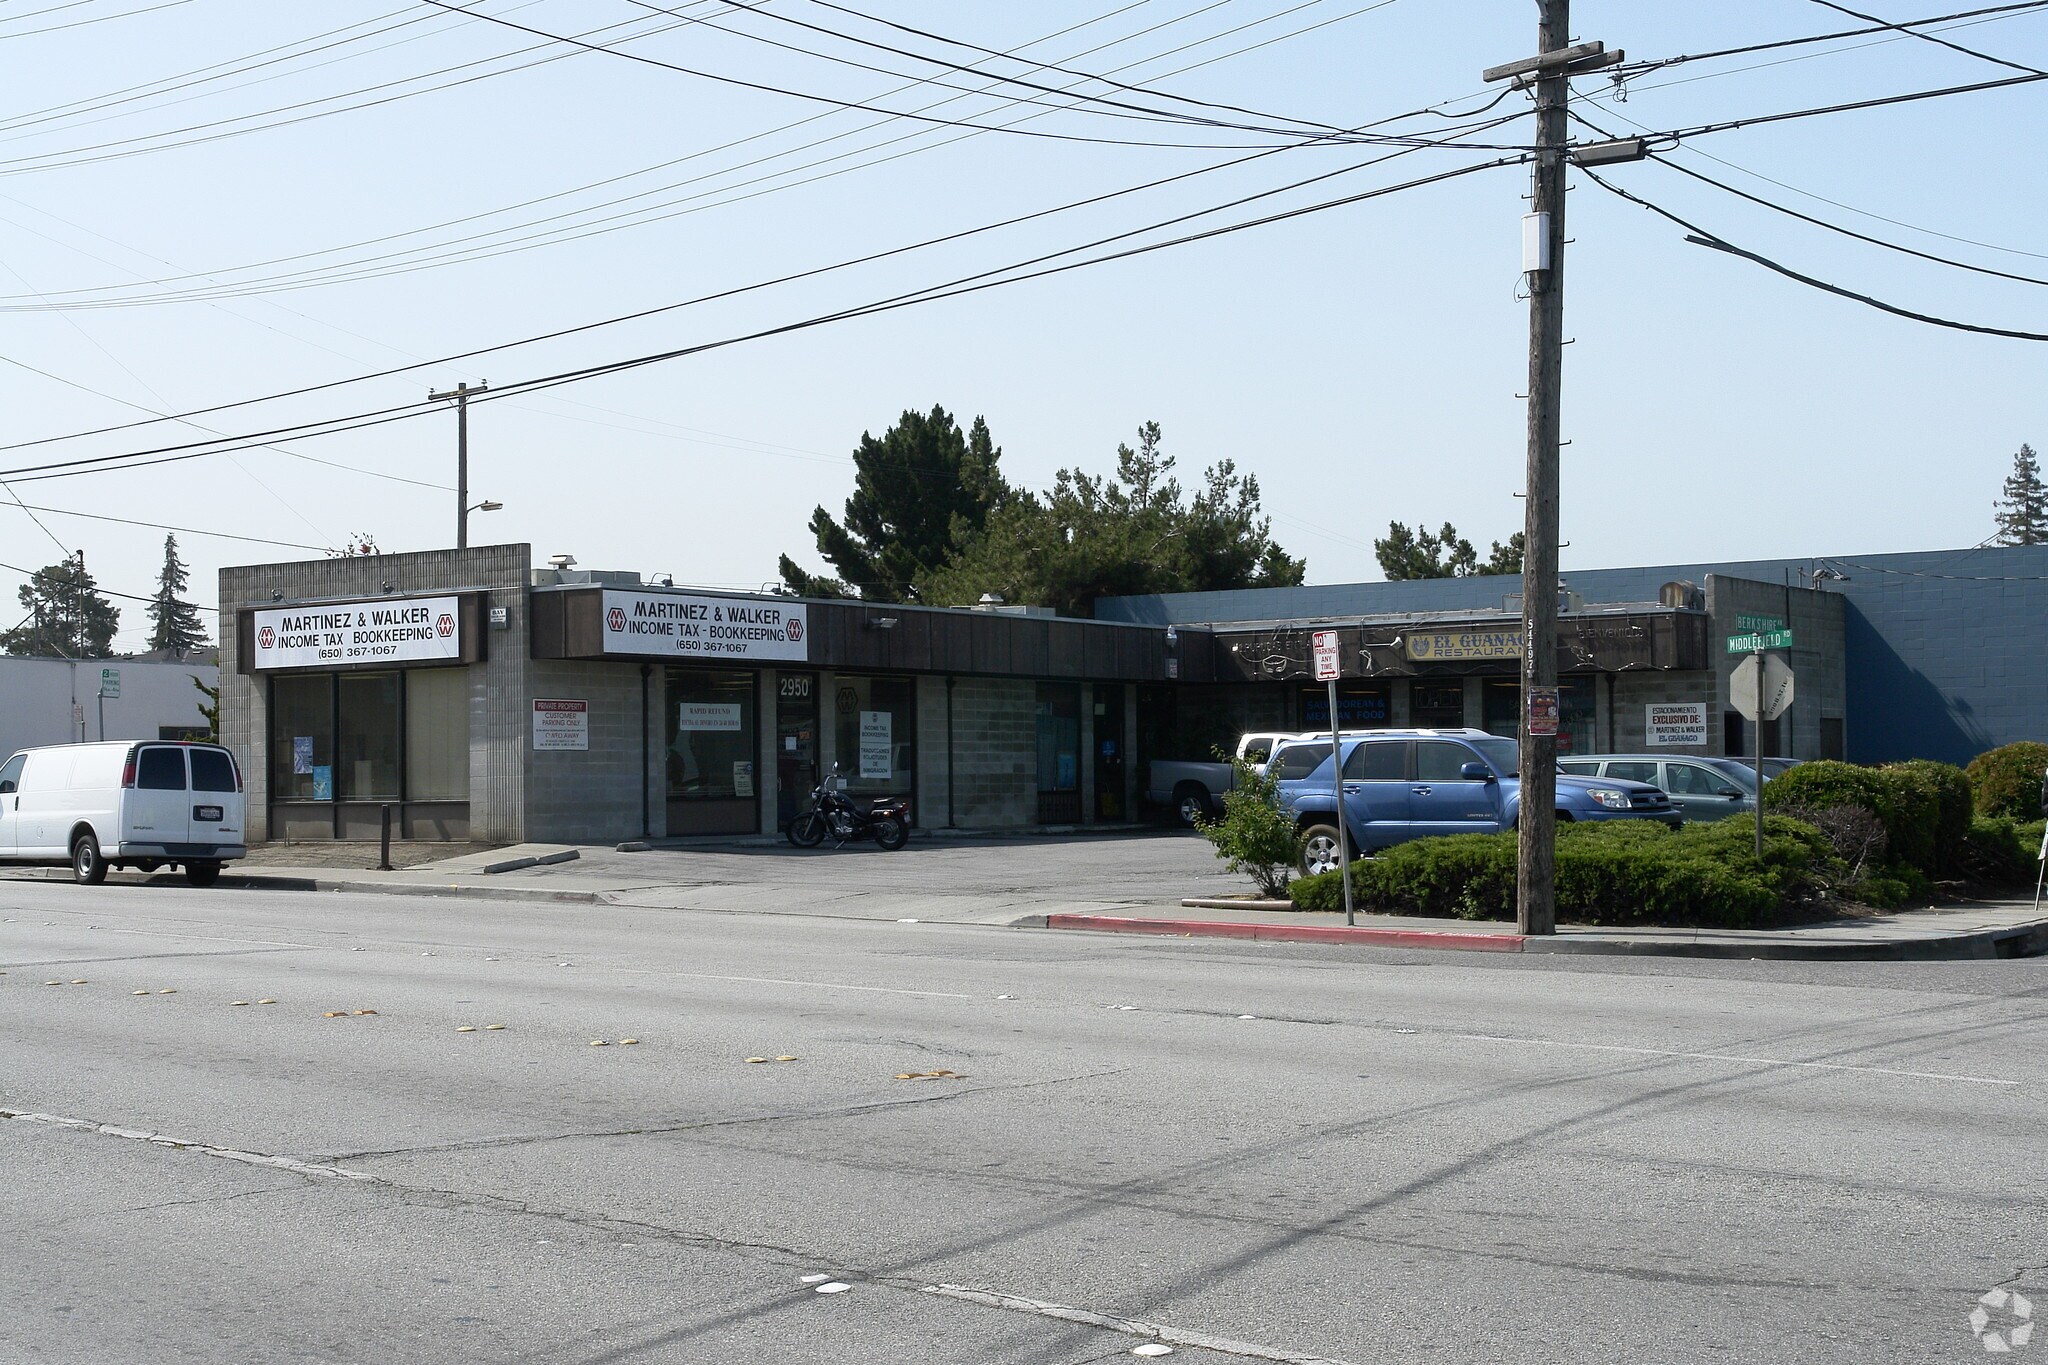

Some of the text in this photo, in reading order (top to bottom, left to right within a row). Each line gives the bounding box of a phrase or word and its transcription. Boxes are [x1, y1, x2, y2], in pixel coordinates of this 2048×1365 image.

[282, 608, 429, 632] MARTINEZ & WALKER
[634, 602, 780, 625] MARTINEZ & WALKER
[629, 620, 674, 636] INCOME
[678, 624, 700, 636] TAX
[710, 626, 785, 642] BOOKKEEPING
[1737, 616, 1776, 632] BERKSHIRE
[278, 626, 434, 648] INCOME TAX BOOKKEEPING
[1314, 636, 1323, 646] NO
[1434, 636, 1454, 648] EL
[1729, 634, 1781, 651] MIDDLEFIELD
[318, 645, 397, 659] (650) 367-1067
[676, 640, 748, 653] (650) 367-1067
[1316, 646, 1335, 654] PARKING
[780, 678, 809, 696] 2950
[1306, 698, 1385, 708] SALVDOREAN &
[1306, 710, 1385, 721] MEXIAN FOOD
[1653, 715, 1701, 724] EXCLUSIVO DE:
